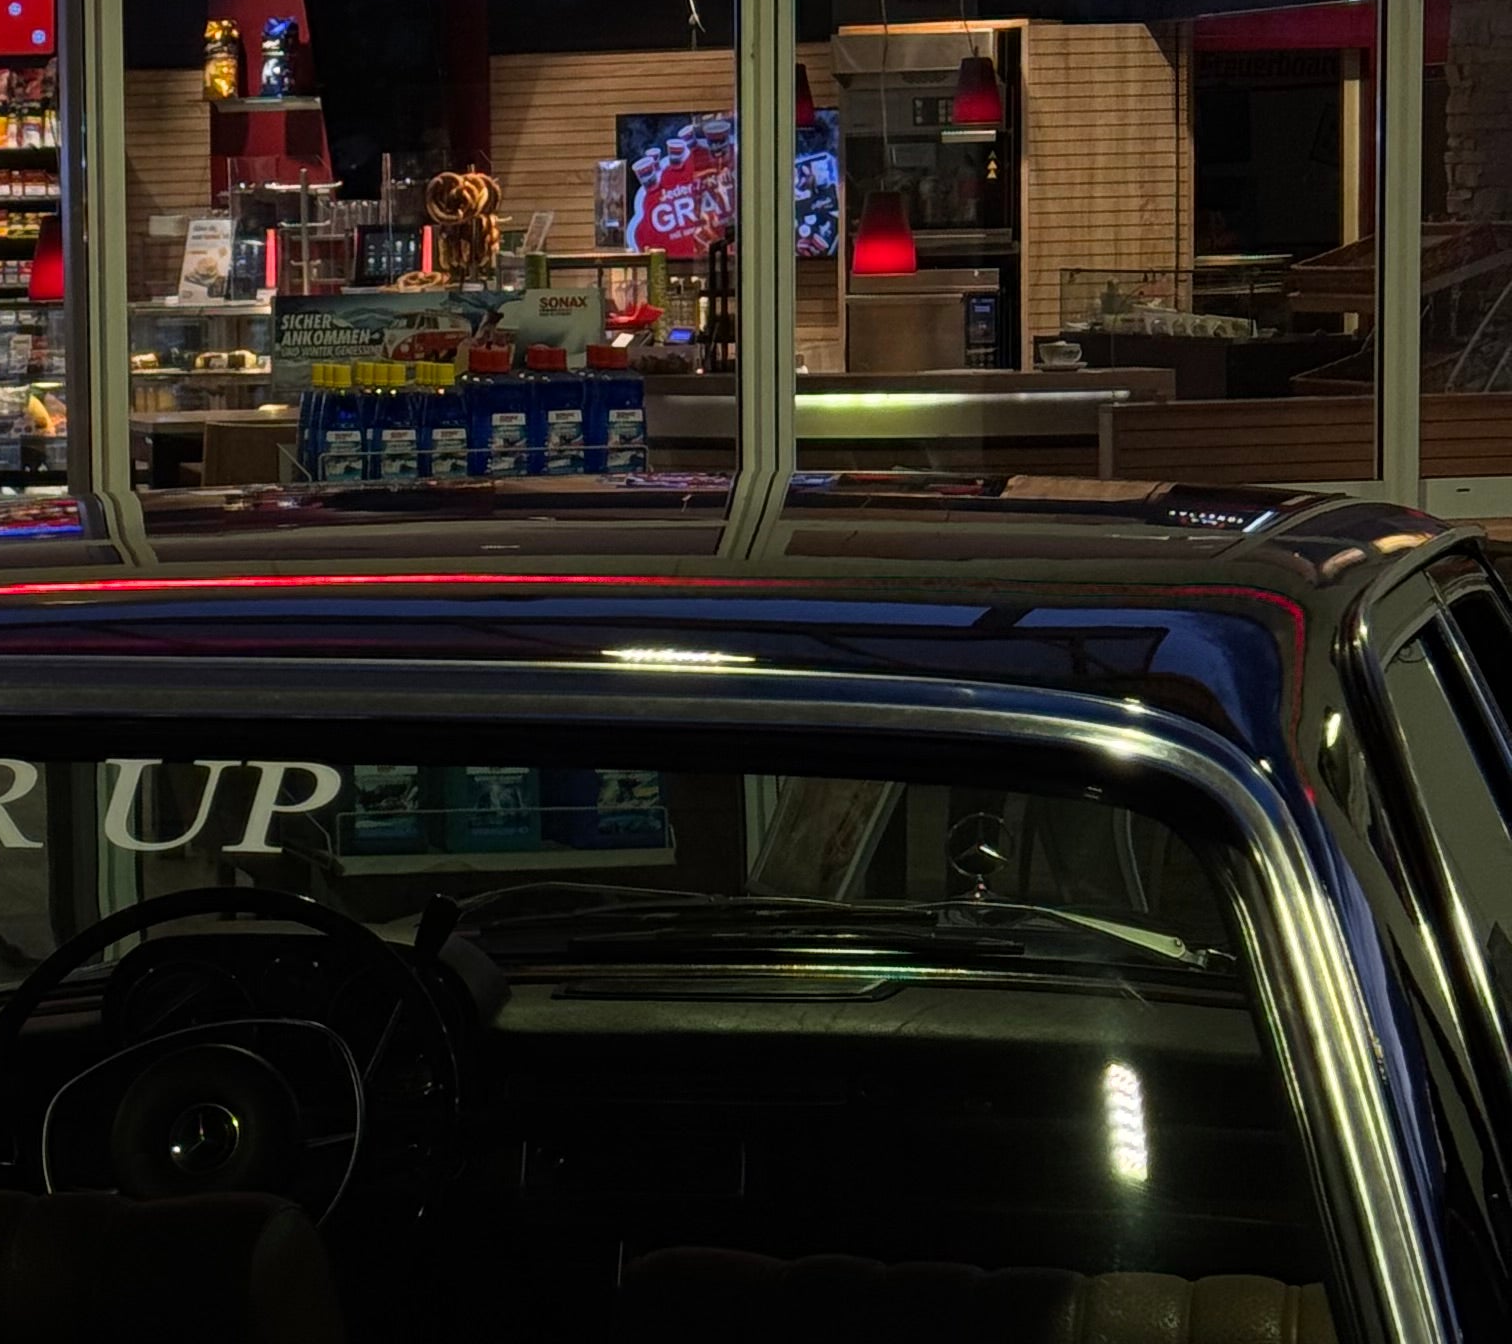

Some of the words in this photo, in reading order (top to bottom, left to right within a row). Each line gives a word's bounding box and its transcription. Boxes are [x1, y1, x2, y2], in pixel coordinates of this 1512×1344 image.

[659, 183, 693, 201] Jeder
[651, 183, 733, 233] GRAT
[538, 295, 588, 309] SONAX
[280, 313, 332, 330] SICHER
[280, 328, 371, 347] ANKOMMEN
[103, 756, 344, 854] UP
